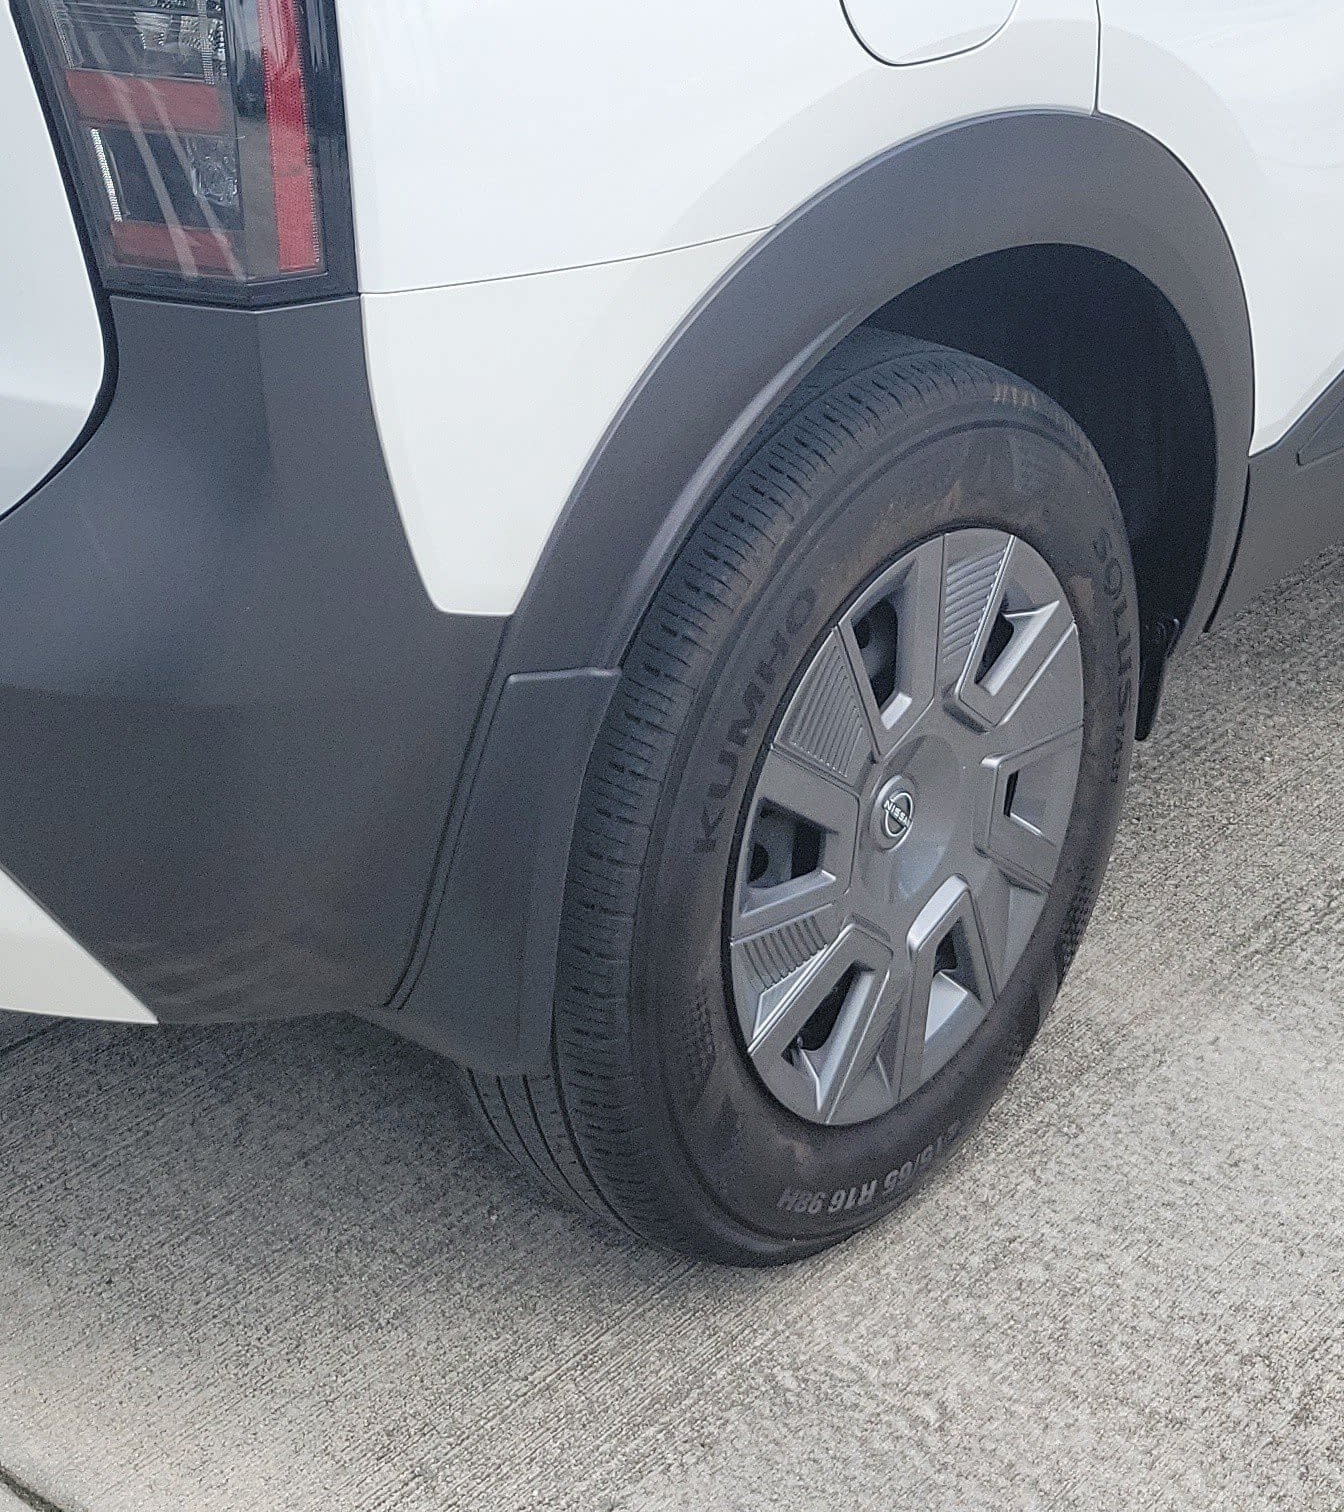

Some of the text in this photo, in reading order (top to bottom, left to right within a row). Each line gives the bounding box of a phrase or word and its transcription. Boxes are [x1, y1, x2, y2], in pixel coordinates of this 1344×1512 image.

[1092, 527, 1133, 717] SOLUS
[694, 587, 817, 854] KUMHO
[827, 1179, 878, 1215] R16
